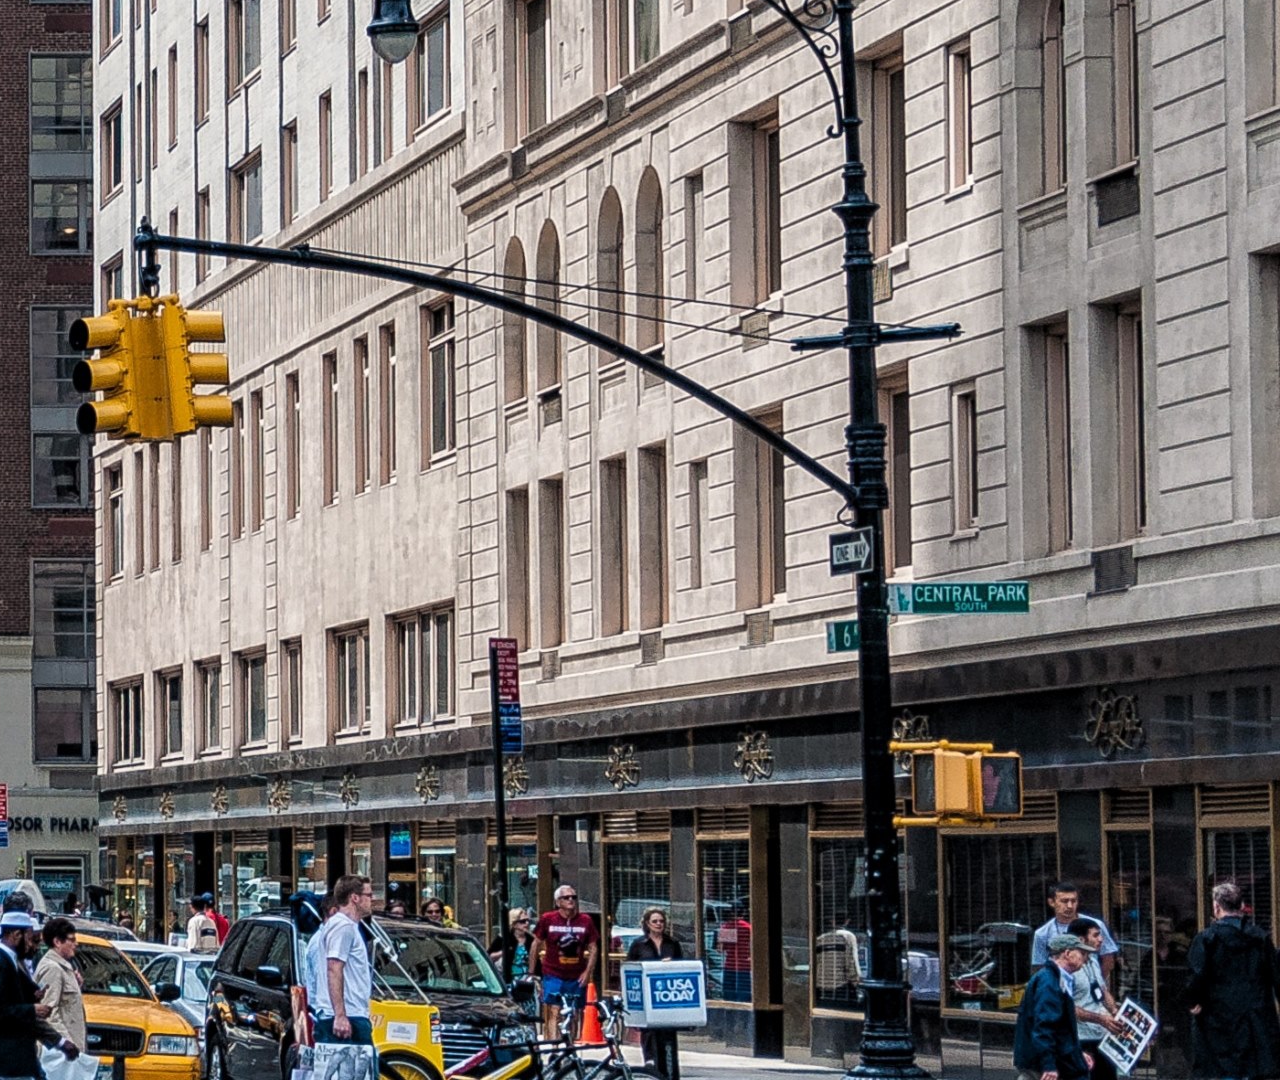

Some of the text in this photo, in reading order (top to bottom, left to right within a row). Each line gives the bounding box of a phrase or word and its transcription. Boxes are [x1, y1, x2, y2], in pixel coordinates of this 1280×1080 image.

[836, 546, 849, 562] ONE
[914, 585, 1026, 603] CENTRAL PARK
[954, 602, 988, 611] SOUTH
[843, 624, 851, 647] 6
[40, 880, 73, 889] PHARMACY
[667, 978, 694, 991] USA
[654, 989, 696, 1003] TODAY
